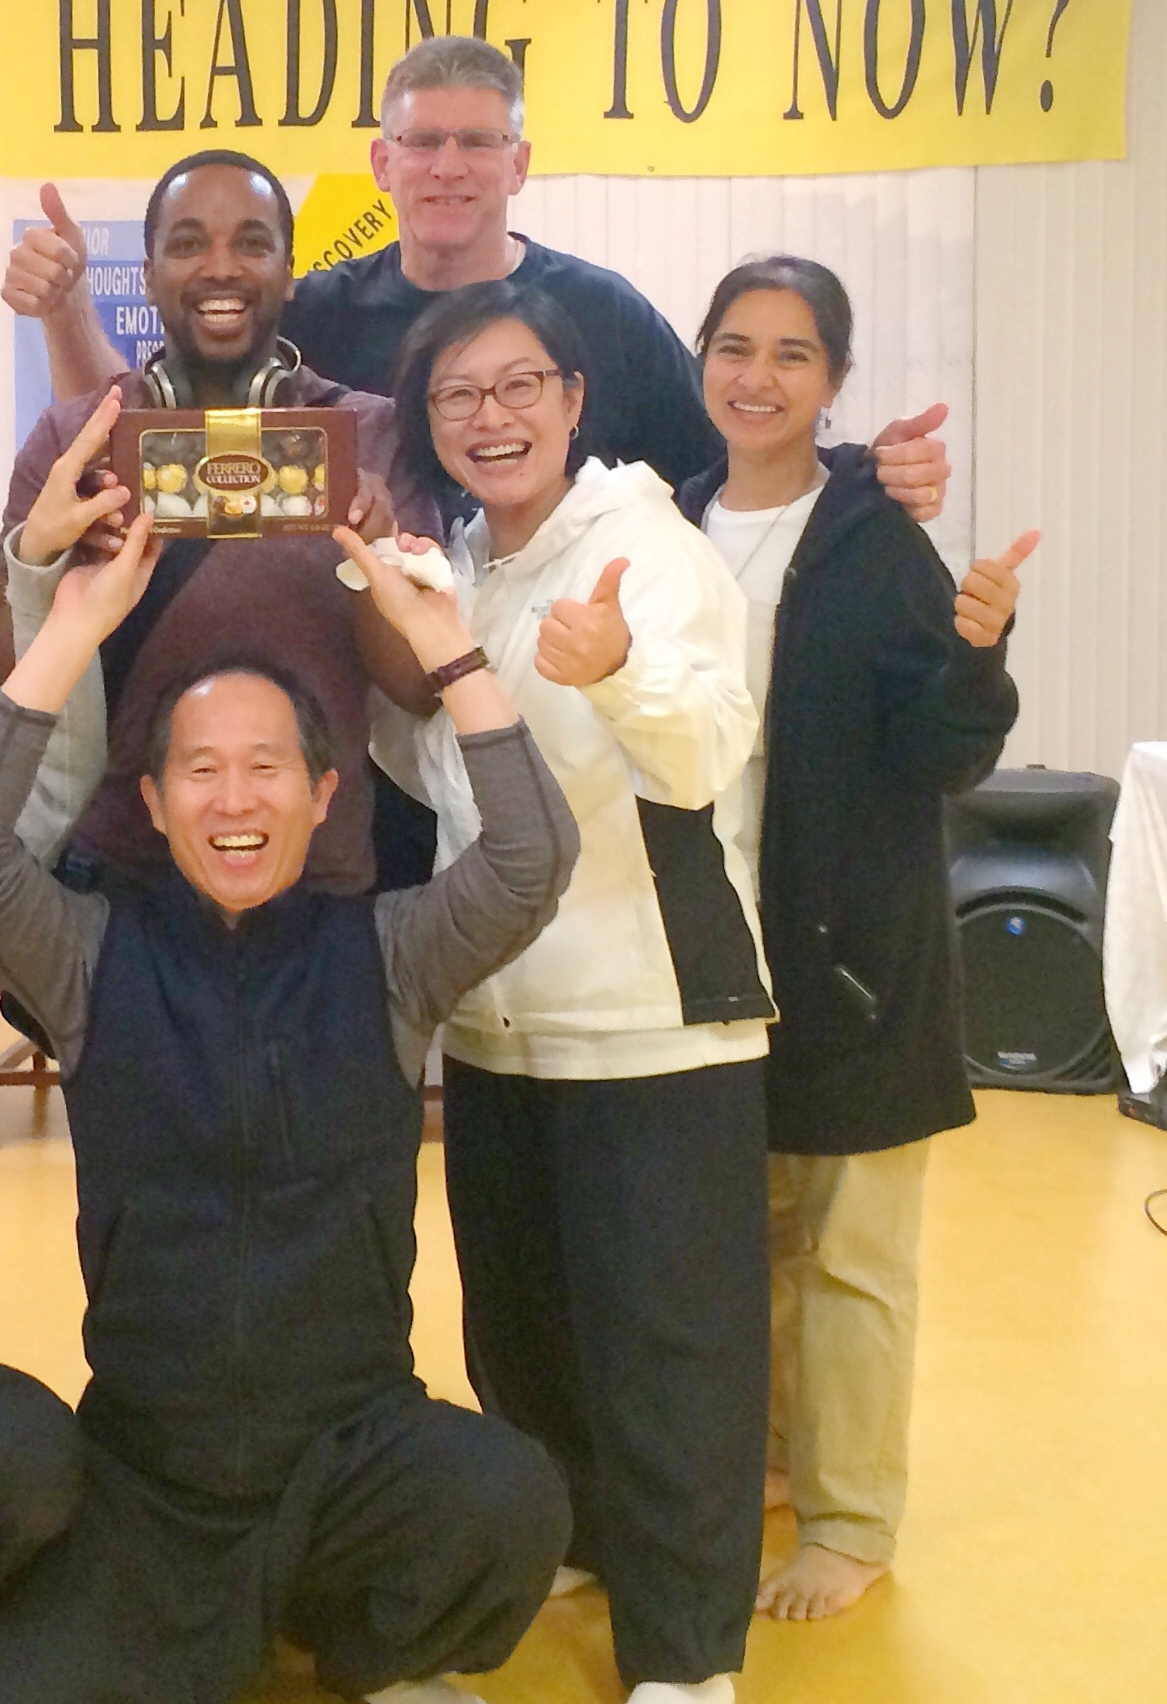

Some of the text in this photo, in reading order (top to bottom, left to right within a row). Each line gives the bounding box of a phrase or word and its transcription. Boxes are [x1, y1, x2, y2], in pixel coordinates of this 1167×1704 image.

[598, 0, 722, 123] TO
[86, 266, 146, 296] HOUGHTS
[206, 461, 262, 475] FERRERO
[205, 475, 262, 485] COLLECTION
